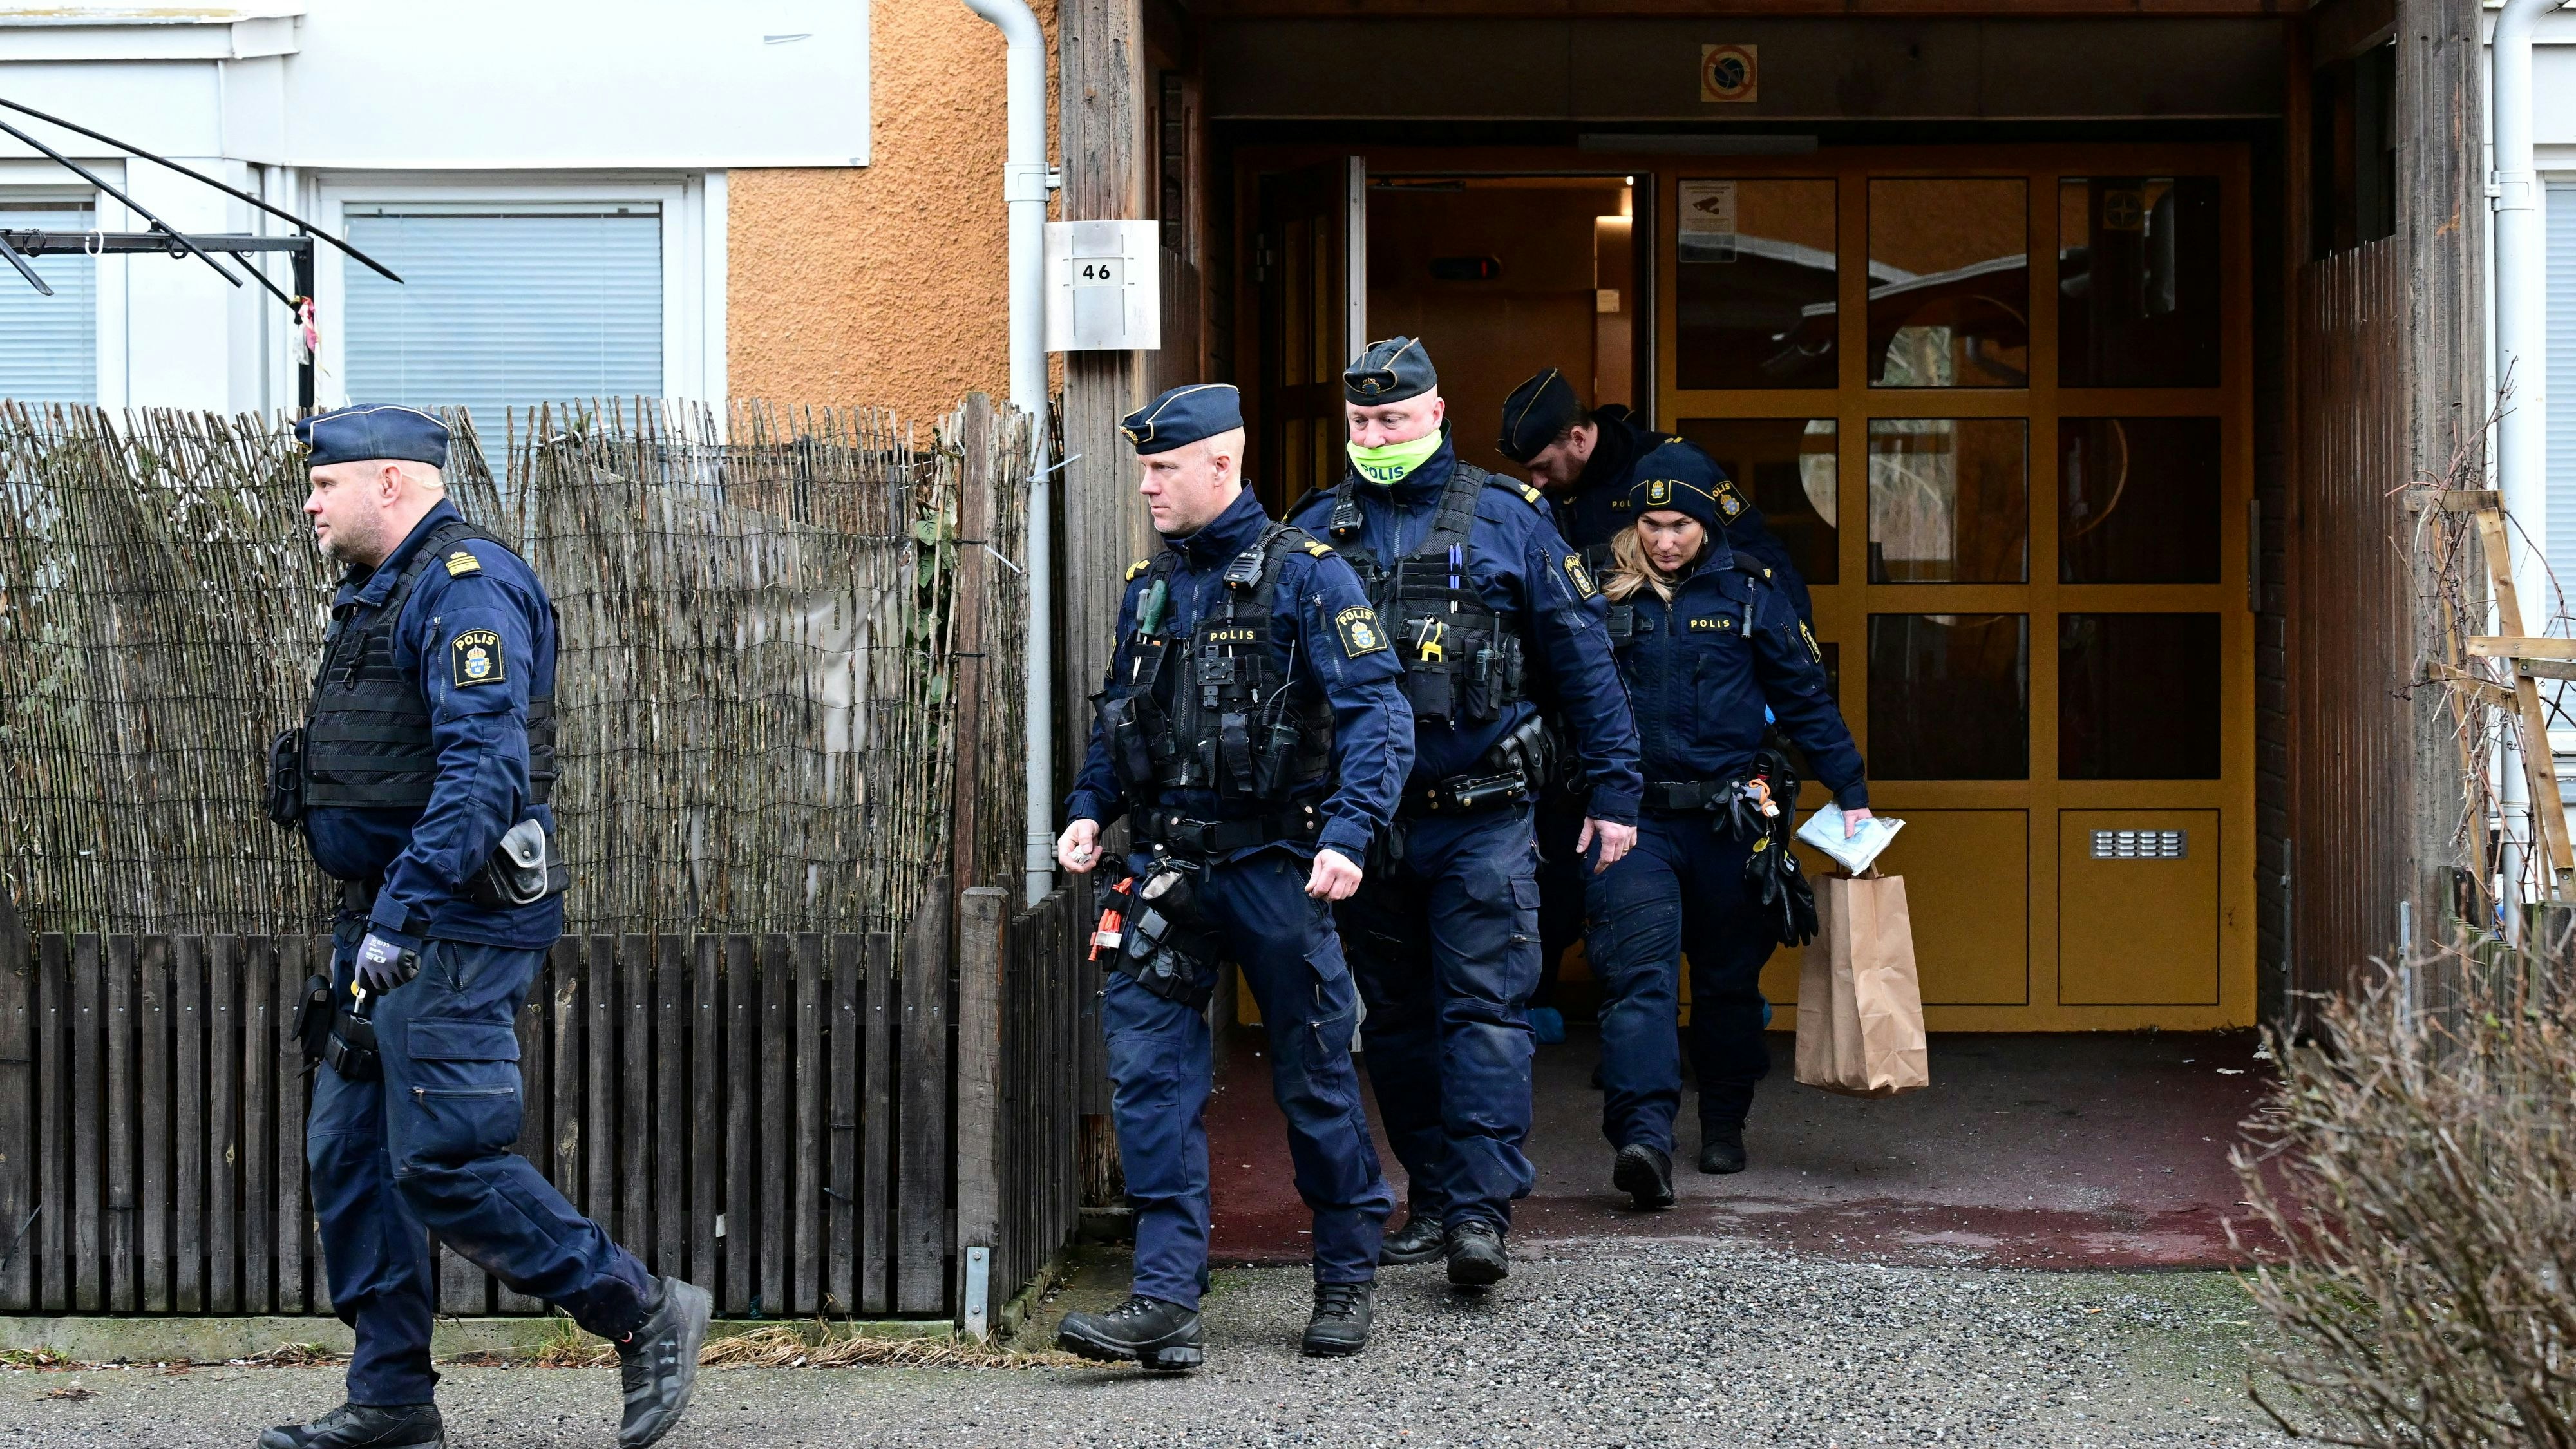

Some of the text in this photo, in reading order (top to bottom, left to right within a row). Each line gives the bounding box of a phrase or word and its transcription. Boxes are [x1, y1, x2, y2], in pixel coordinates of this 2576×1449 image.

[1083, 265, 1110, 279] 46
[1712, 483, 1730, 497] OLIS
[1612, 500, 1631, 508] POL
[1339, 610, 1372, 626] POLIS
[1690, 620, 1730, 628] POLIS
[455, 634, 496, 650] POLIS
[1210, 630, 1254, 641] POLIS
